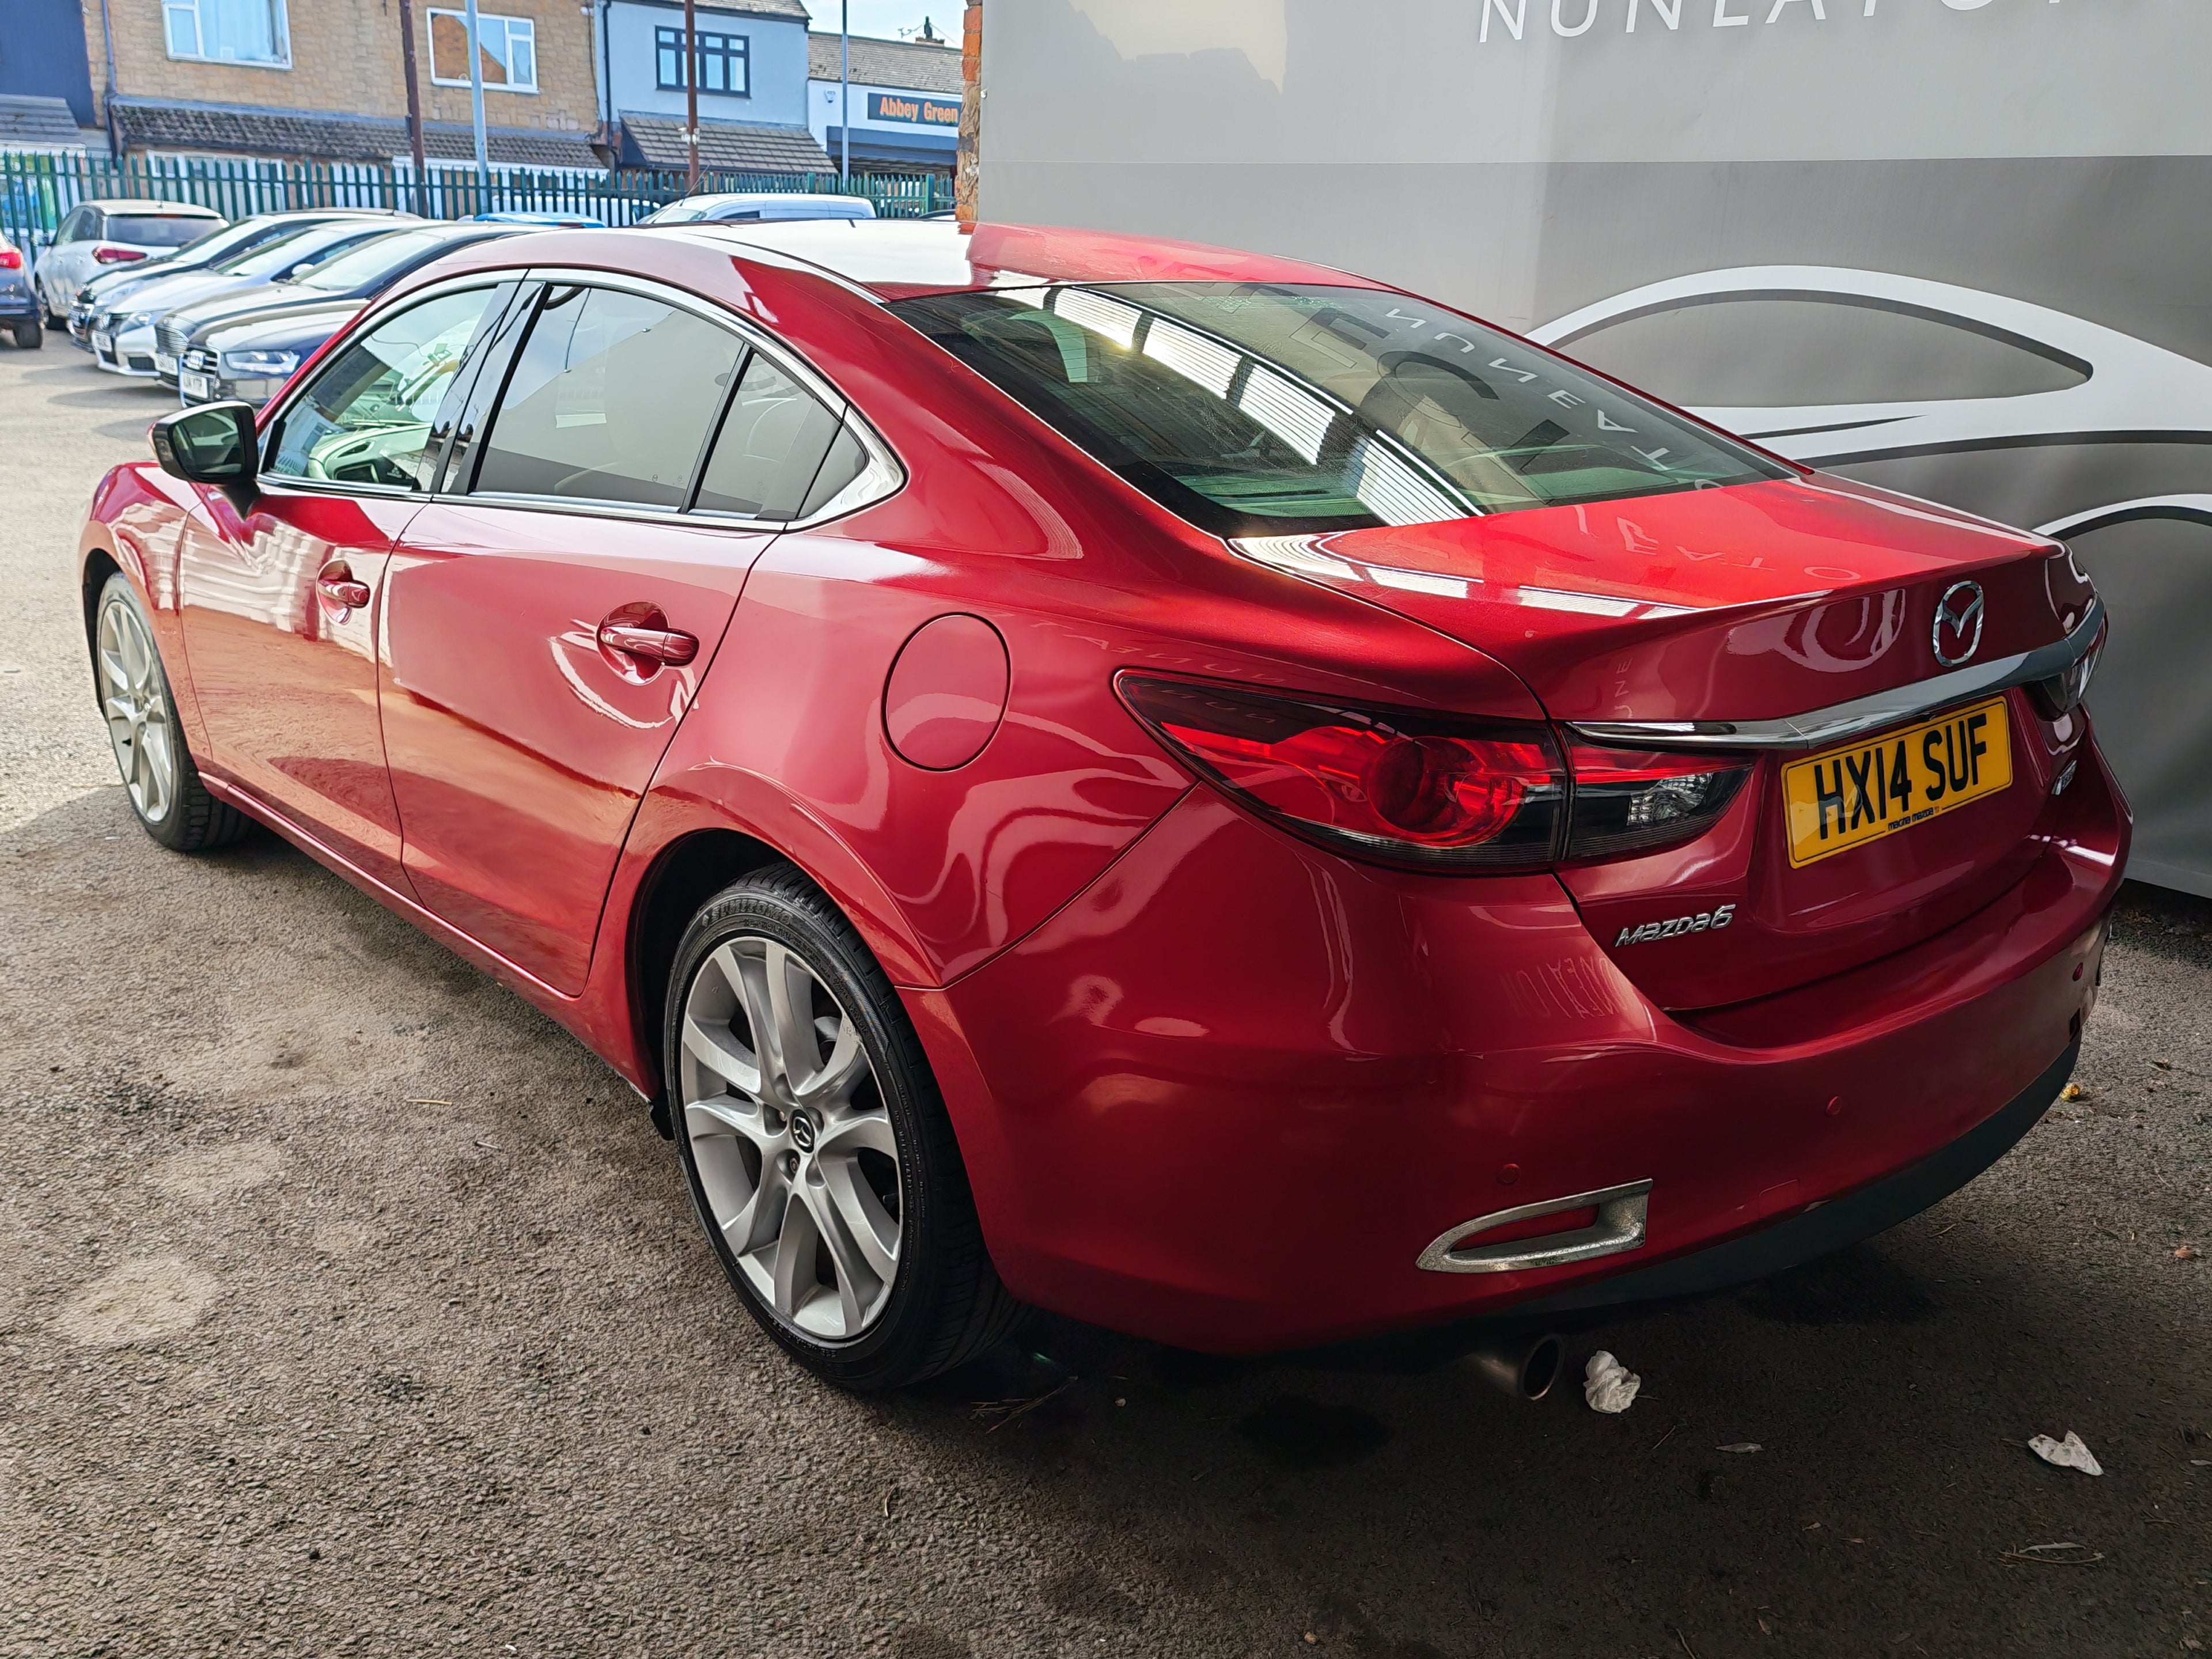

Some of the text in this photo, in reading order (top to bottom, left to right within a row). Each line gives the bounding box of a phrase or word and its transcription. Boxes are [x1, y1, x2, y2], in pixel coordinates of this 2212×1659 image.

[879, 96, 958, 123] Abbey Green
[1814, 713, 1987, 840] HX14 SUF
